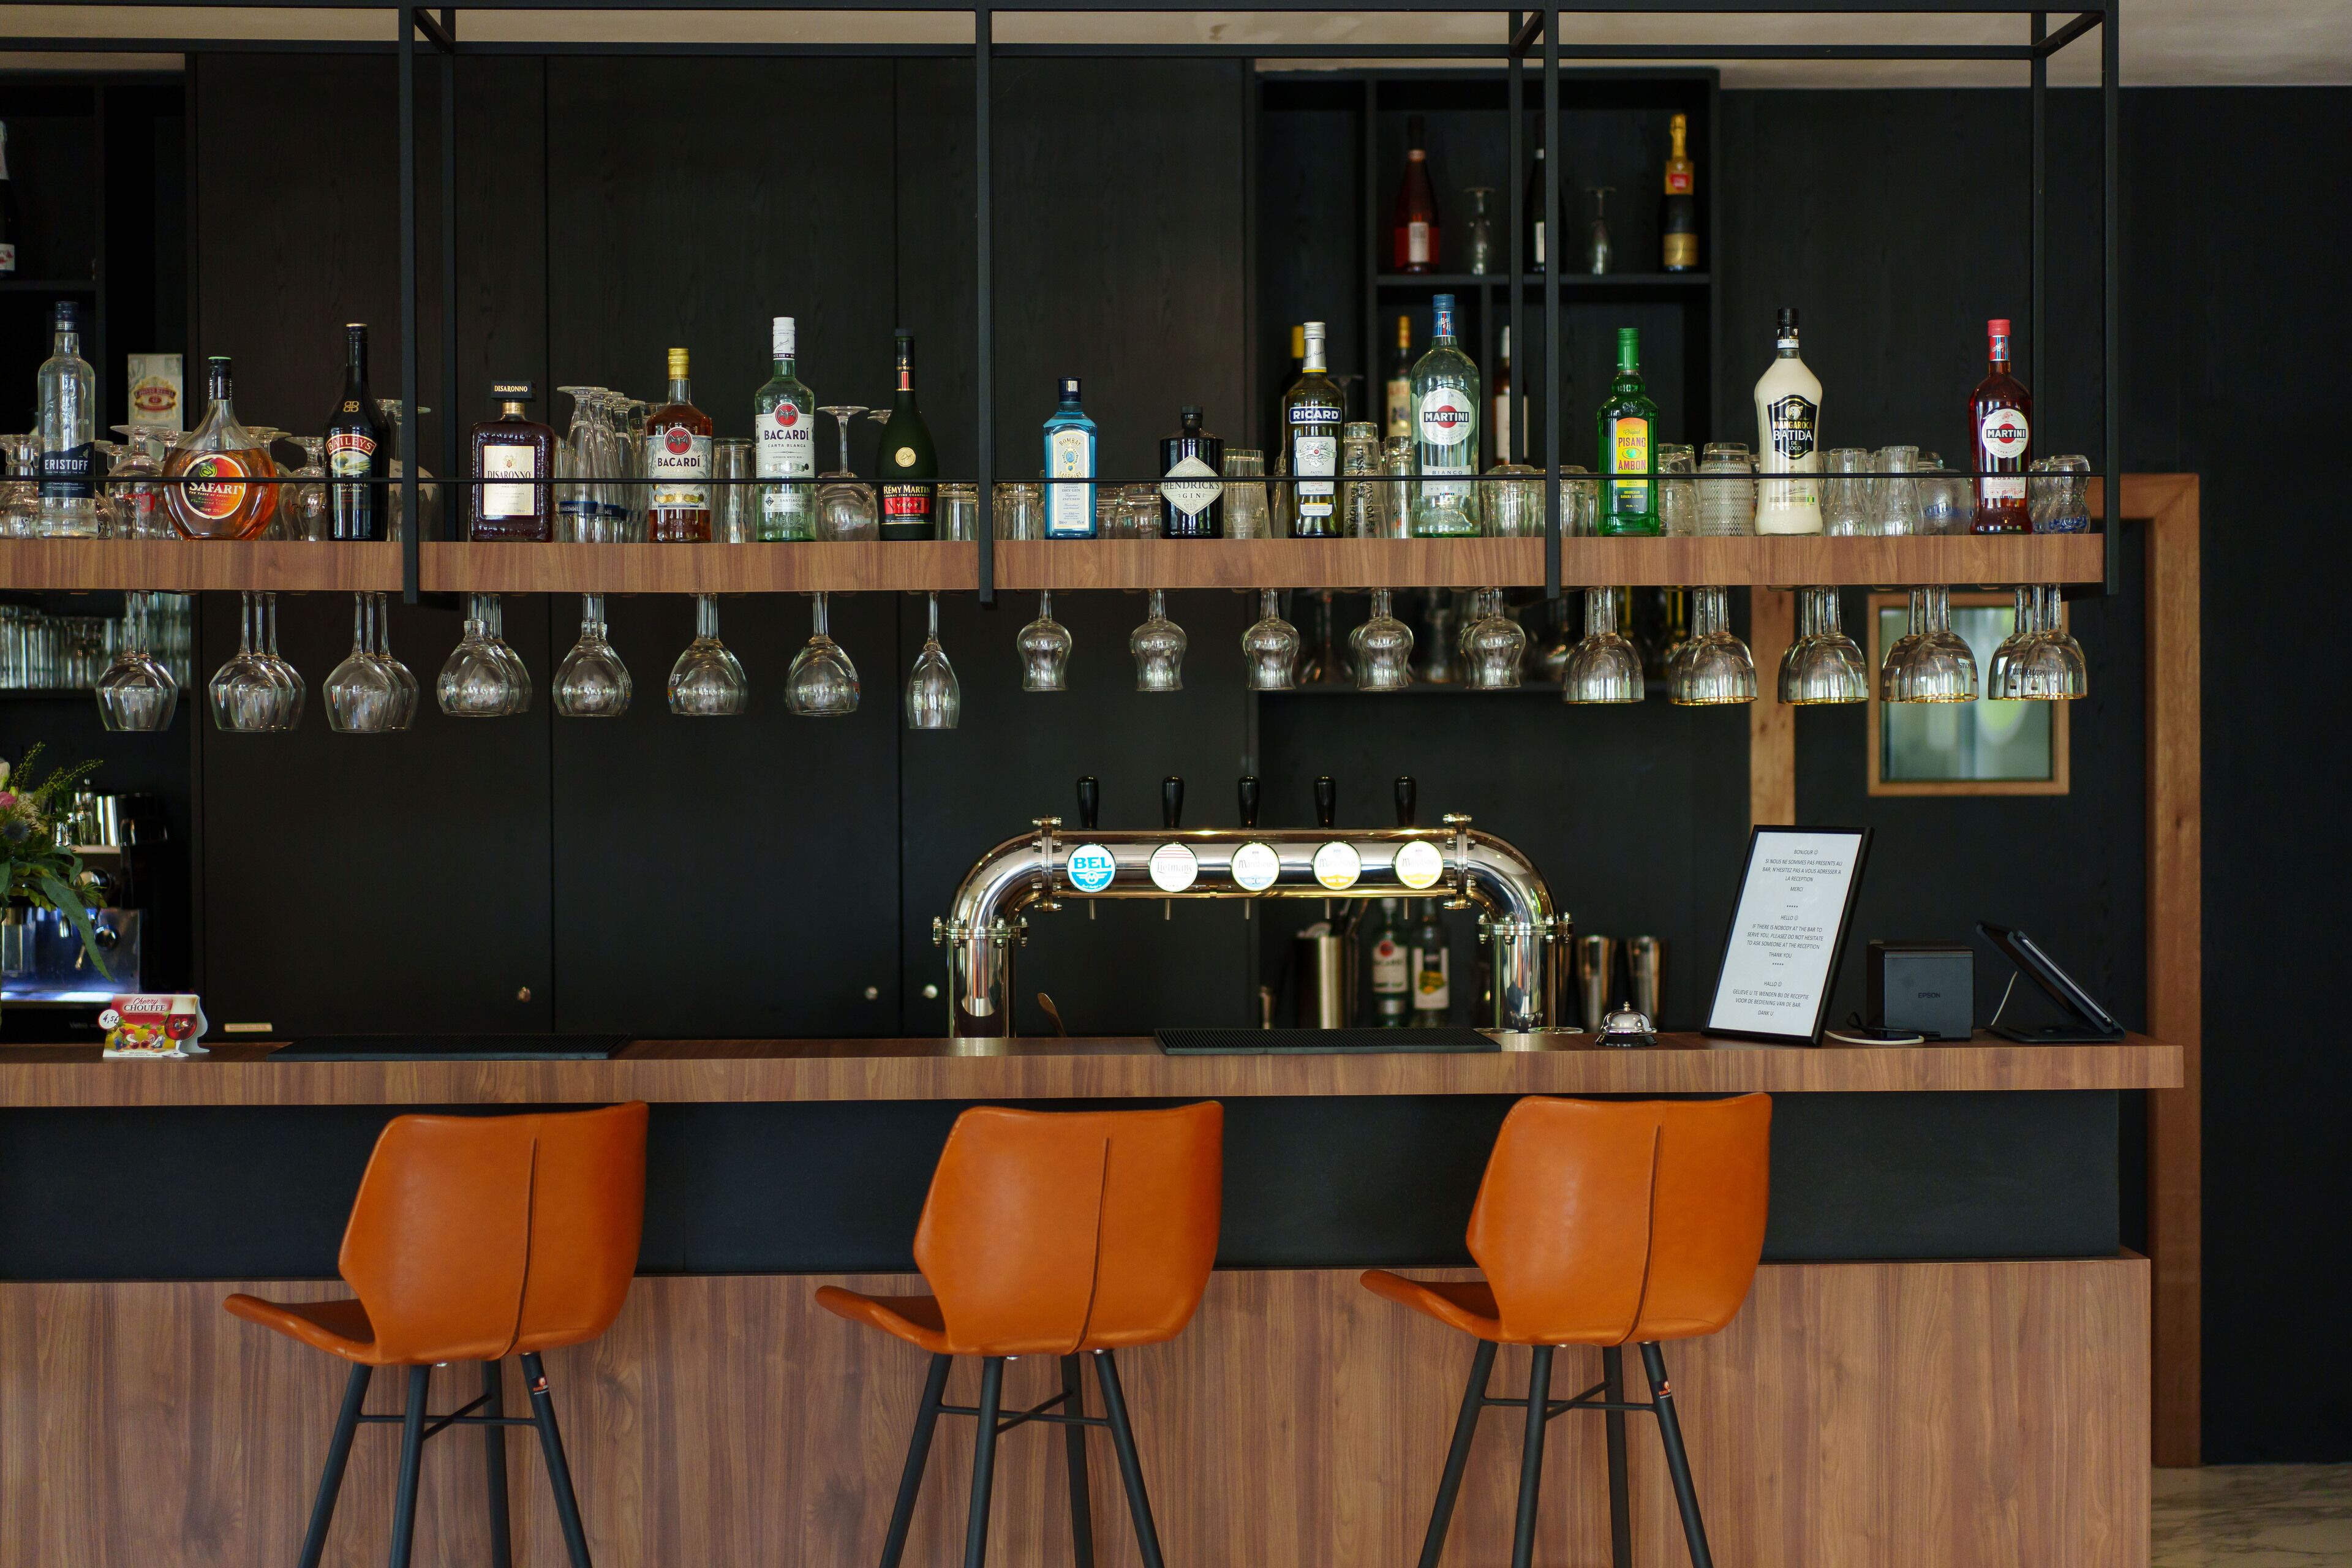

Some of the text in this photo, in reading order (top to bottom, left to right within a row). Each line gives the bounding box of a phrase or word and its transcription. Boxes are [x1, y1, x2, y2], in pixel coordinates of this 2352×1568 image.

[1293, 410, 1339, 419] RICARD
[1425, 412, 1468, 421] MARTINI
[764, 428, 809, 440] BACARDÍ
[1773, 430, 1813, 440] BATIDA
[328, 437, 371, 451] BAILEYS
[1059, 437, 1082, 448] BOMBAY
[1618, 437, 1646, 447] PISANG
[45, 459, 88, 470] ERISTOFF
[657, 455, 700, 467] BACARDÍ
[1618, 460, 1646, 470] AMBON
[189, 483, 239, 494] SAFARI
[884, 485, 902, 494] RÉMY
[1074, 857, 1112, 869] BEL
[1157, 861, 1192, 874] Liefmans
